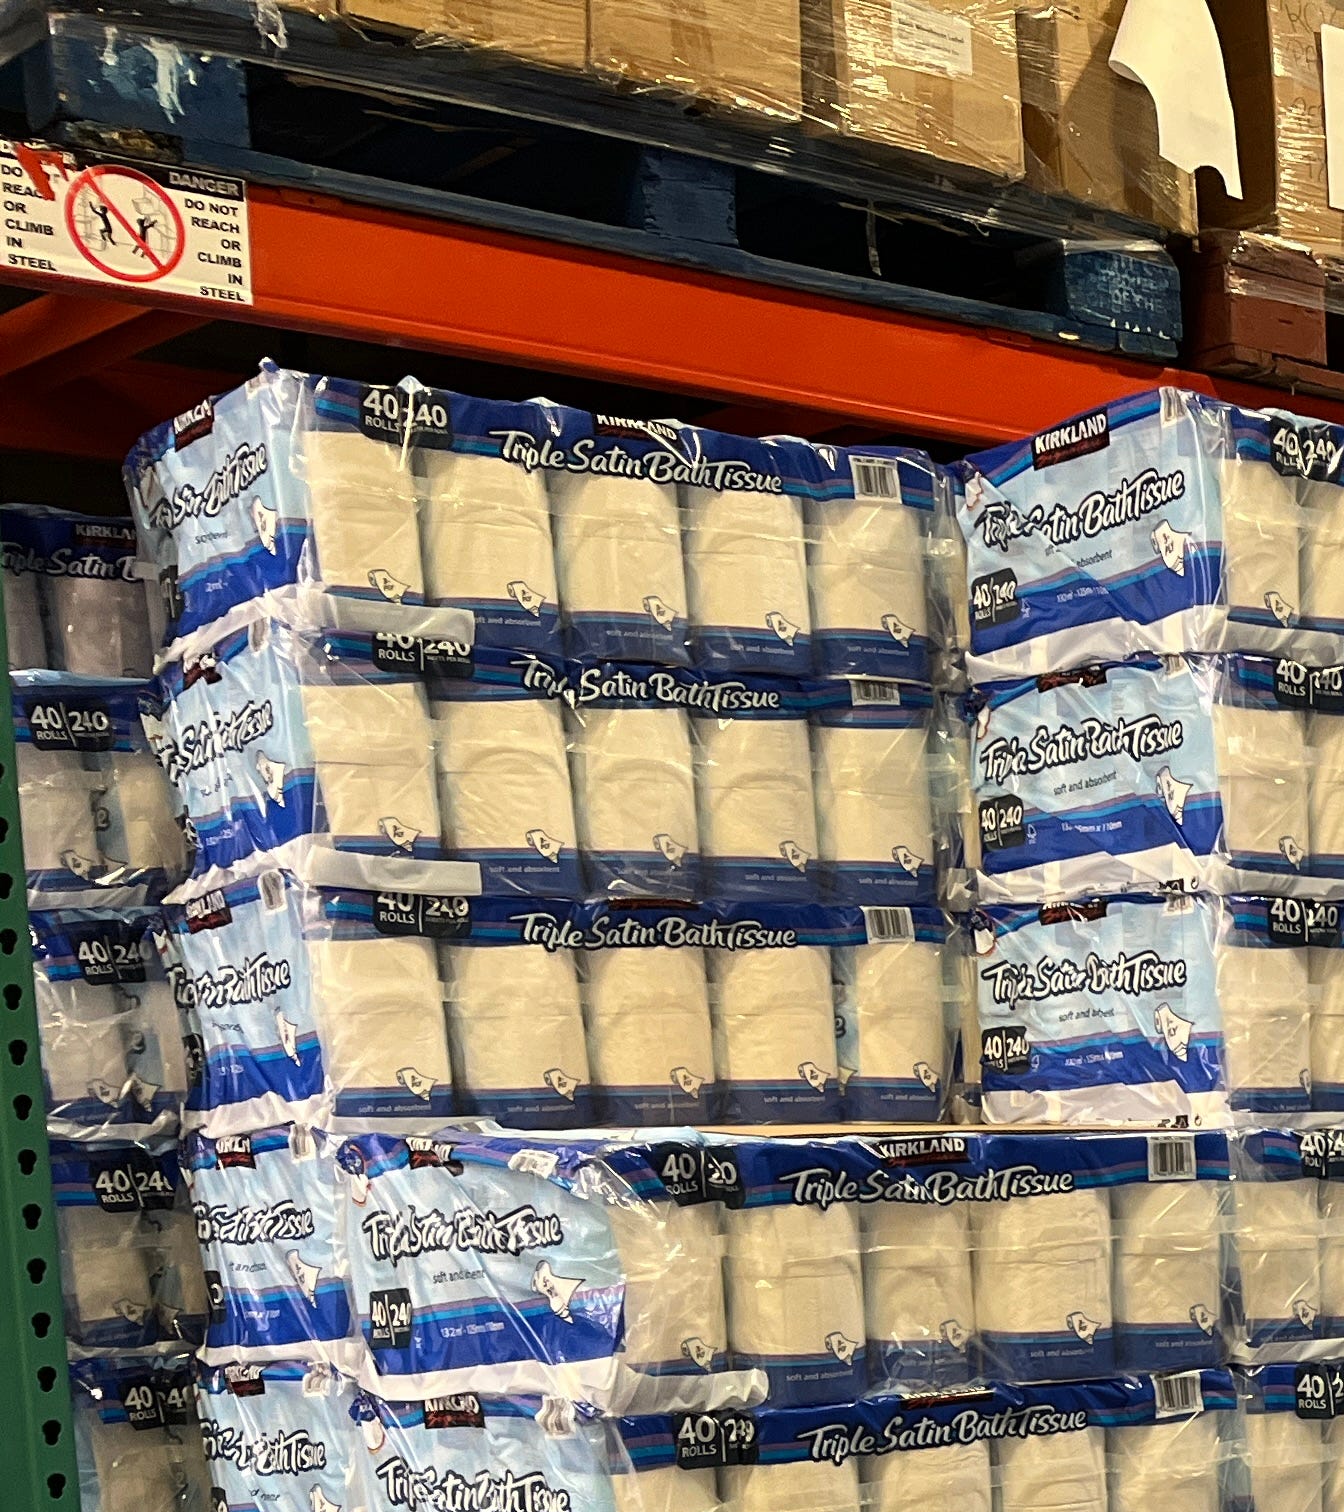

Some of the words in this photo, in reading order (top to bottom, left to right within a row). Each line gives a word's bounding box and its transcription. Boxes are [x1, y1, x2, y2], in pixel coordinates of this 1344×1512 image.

[1, 164, 23, 177] DO
[3, 182, 44, 199] REAC
[169, 171, 239, 195] DANGER
[4, 201, 27, 213] OR
[185, 198, 205, 211] DO
[209, 203, 238, 217] NOT
[5, 218, 54, 236] CLIMB
[191, 217, 240, 233] REACH
[7, 236, 23, 249] IN
[221, 239, 241, 251] OR
[8, 254, 57, 272] STEEL
[198, 252, 242, 268] CLIMB
[228, 273, 243, 285] IN
[200, 286, 245, 302] STEEL
[363, 389, 398, 420] 40
[1035, 413, 1106, 453] KIRKLAND
[489, 430, 564, 473] Triple
[567, 439, 643, 477] Satin
[709, 461, 782, 493] Tissue
[1079, 479, 1134, 537] Bath
[1124, 468, 1185, 520] Tissue
[879, 1139, 965, 1158] KIRKLAND
[780, 1169, 858, 1210] Triple
[927, 1174, 999, 1204] Bath
[995, 1166, 1074, 1198] Tissue
[679, 1420, 715, 1444] 40
[798, 1424, 875, 1466] Triple
[877, 1415, 952, 1453] Satin
[953, 1410, 1018, 1441] Bath
[1015, 1406, 1086, 1431] Tissue
[682, 1444, 716, 1457] ROLLS
